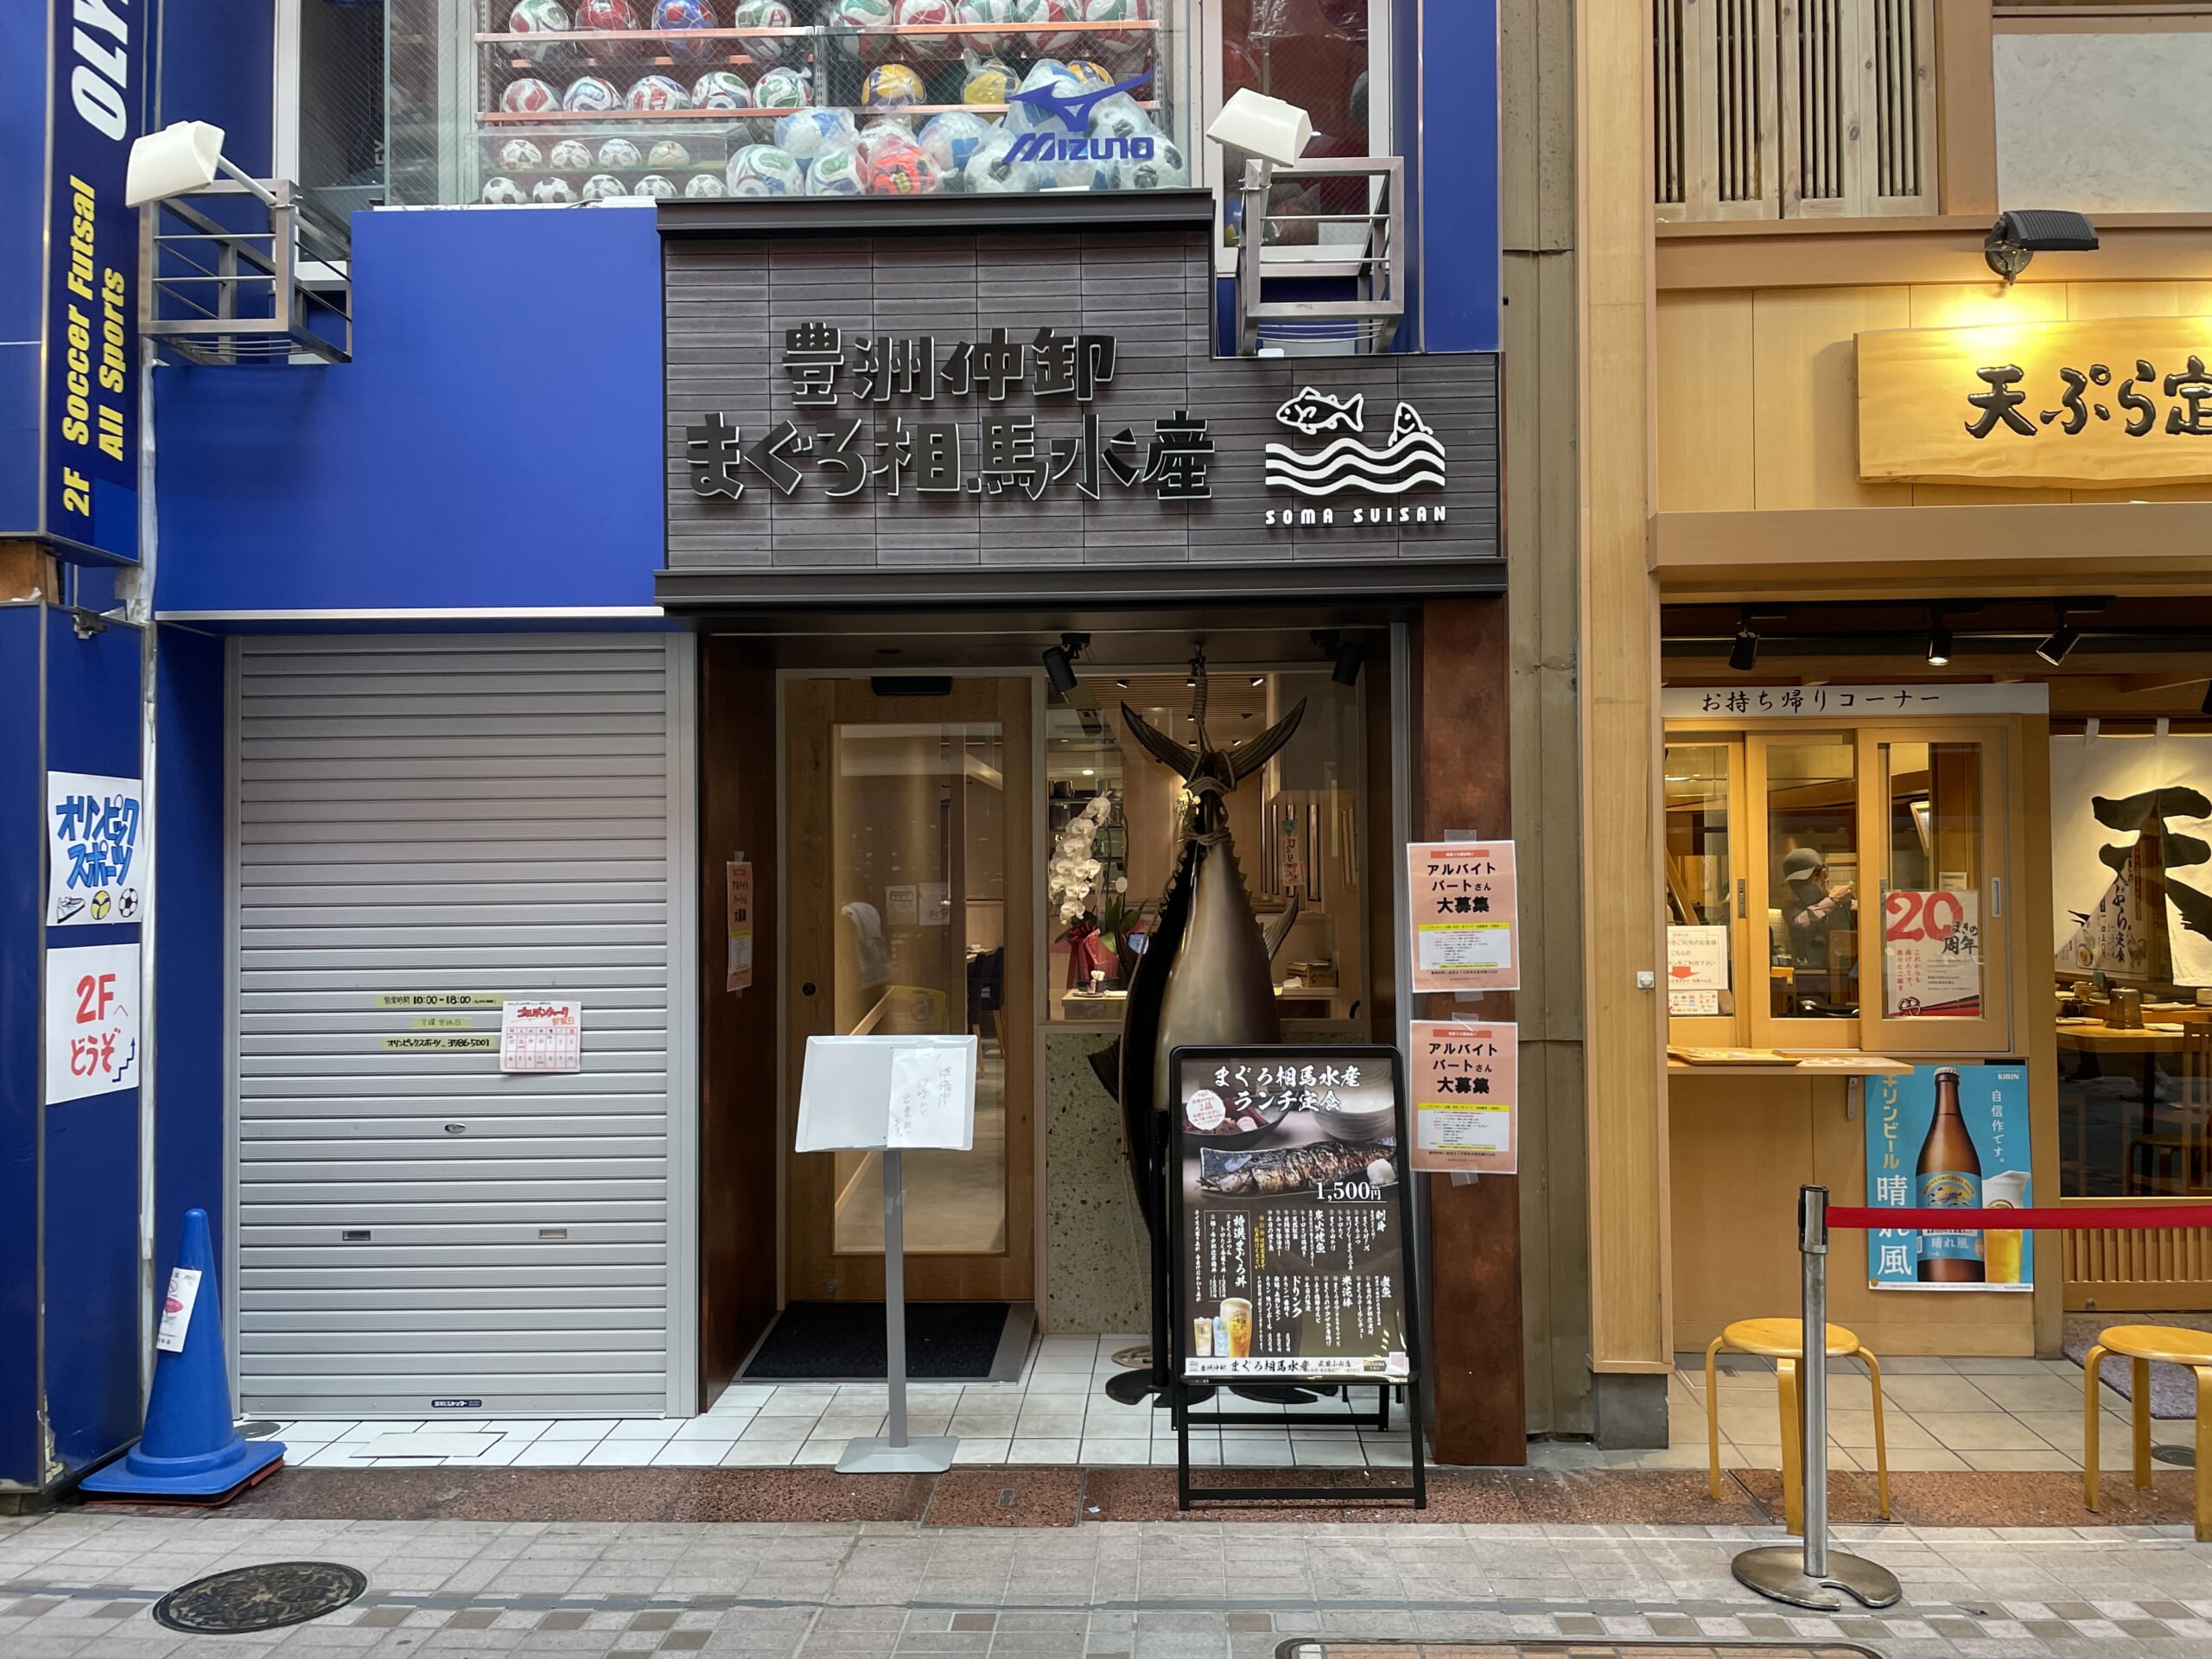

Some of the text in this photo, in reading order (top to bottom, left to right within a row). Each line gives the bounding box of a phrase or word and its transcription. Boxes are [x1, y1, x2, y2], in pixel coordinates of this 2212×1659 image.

[72, 0, 129, 141] OLY
[63, 175, 96, 517] 2F Soccer Futsal
[98, 267, 125, 461] All Sports
[781, 321, 1118, 406] 豊洲仲卸
[685, 409, 1217, 502] まぐろ相馬水産
[1264, 505, 1448, 526] SOMA SUISAN
[1700, 689, 1941, 714] お持ち帰りコーナー
[55, 793, 140, 847] オリンピック
[66, 839, 133, 890] スポーツ
[1427, 861, 1497, 876] アルバイト
[1436, 896, 1490, 913] 大募集
[1885, 891, 1963, 943] 20
[1951, 920, 1978, 937] まきの
[1942, 935, 1978, 955] 周年
[69, 1027, 122, 1077] どうぞ
[1428, 1043, 1498, 1057] アルバイト
[1213, 1065, 1362, 1088] まぐろ相馬水産
[1437, 1077, 1490, 1094] 大募集
[1234, 1090, 1342, 1112] ランチ定食
[1990, 1090, 2005, 1163] 自信作です。
[1314, 1180, 1382, 1203] 1,500円
[1230, 1359, 1311, 1373] まぐろ相馬水産
